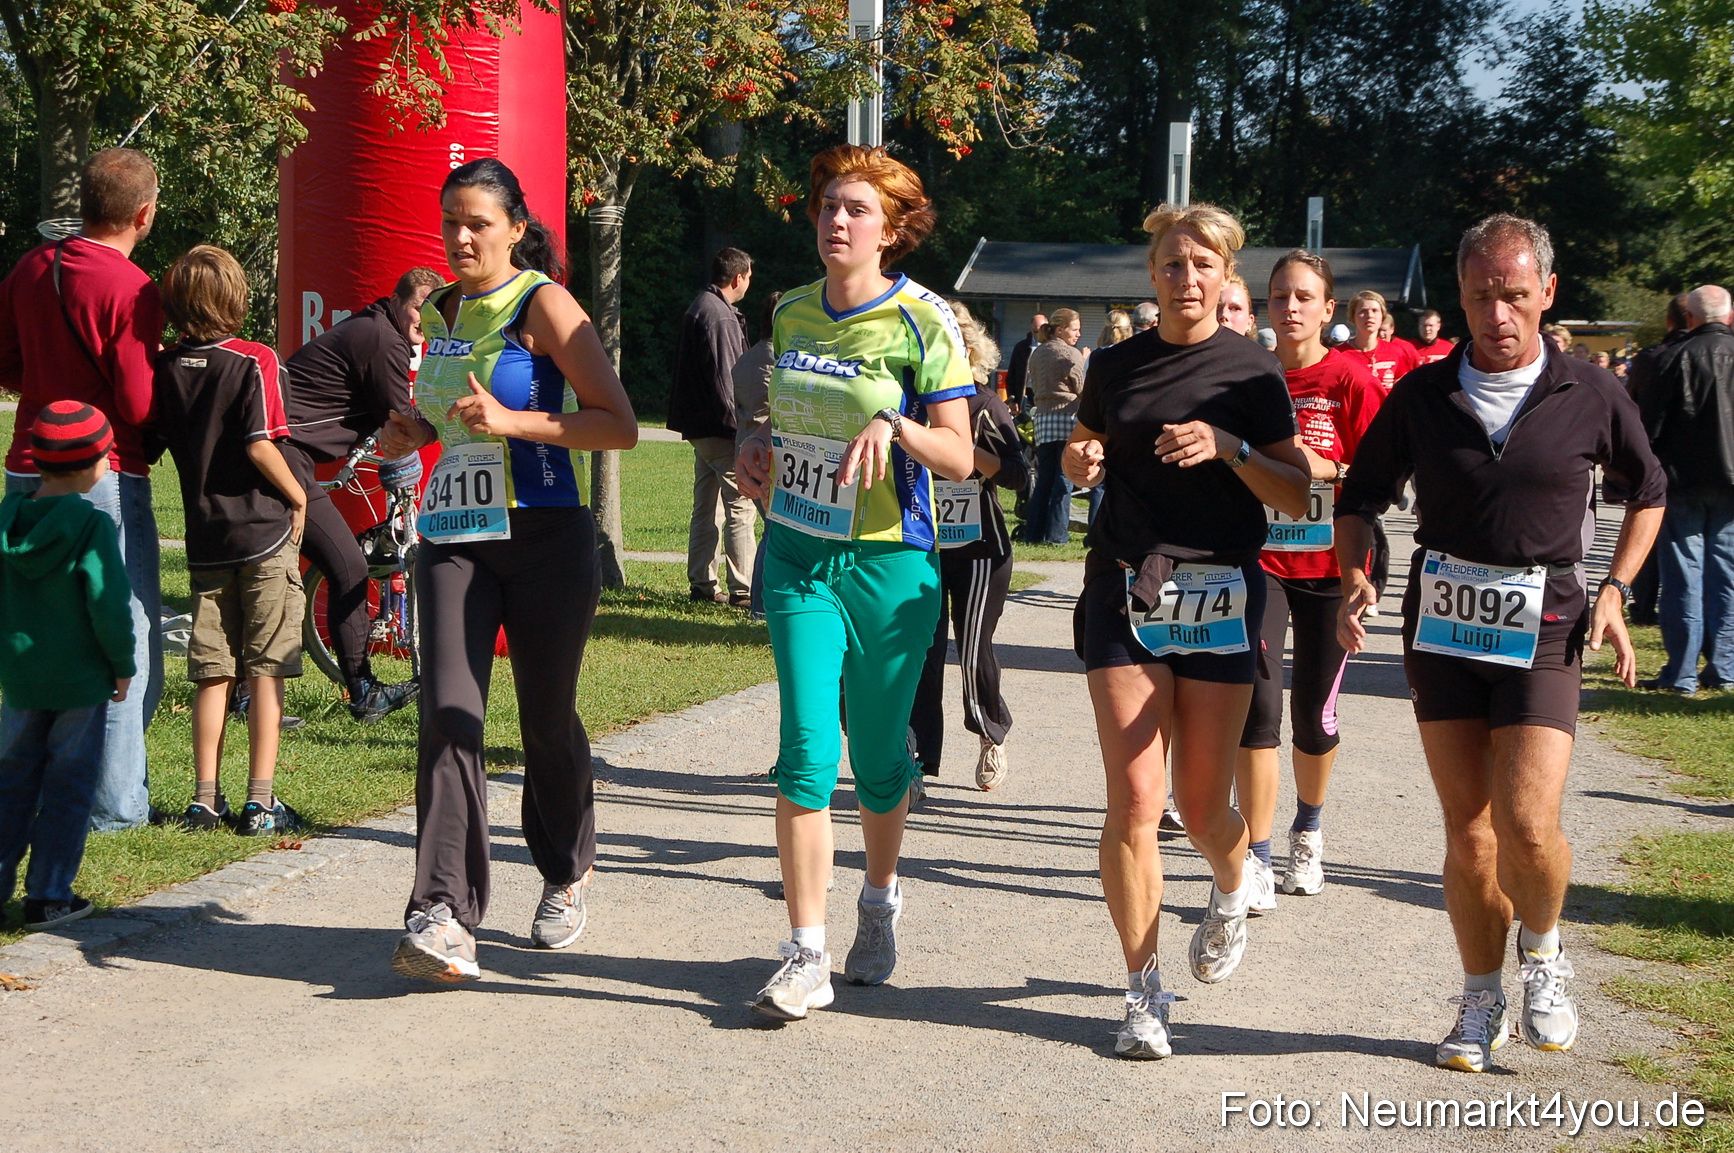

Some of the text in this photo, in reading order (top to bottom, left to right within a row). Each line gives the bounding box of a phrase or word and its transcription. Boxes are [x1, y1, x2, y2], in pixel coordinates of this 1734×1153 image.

[775, 350, 864, 378] BOCK
[1294, 396, 1341, 409] NEUMARKTER
[426, 469, 493, 511] 3410
[782, 452, 841, 504] 3411
[428, 509, 488, 532] Claudia
[783, 493, 831, 526] Miriam
[1268, 524, 1306, 541] Karin
[1440, 563, 1490, 577] PFLEIDERER
[1143, 586, 1233, 623] 2774
[1433, 580, 1527, 629] 3092
[1169, 624, 1211, 645] Ruth
[1451, 622, 1501, 652] Luigi
